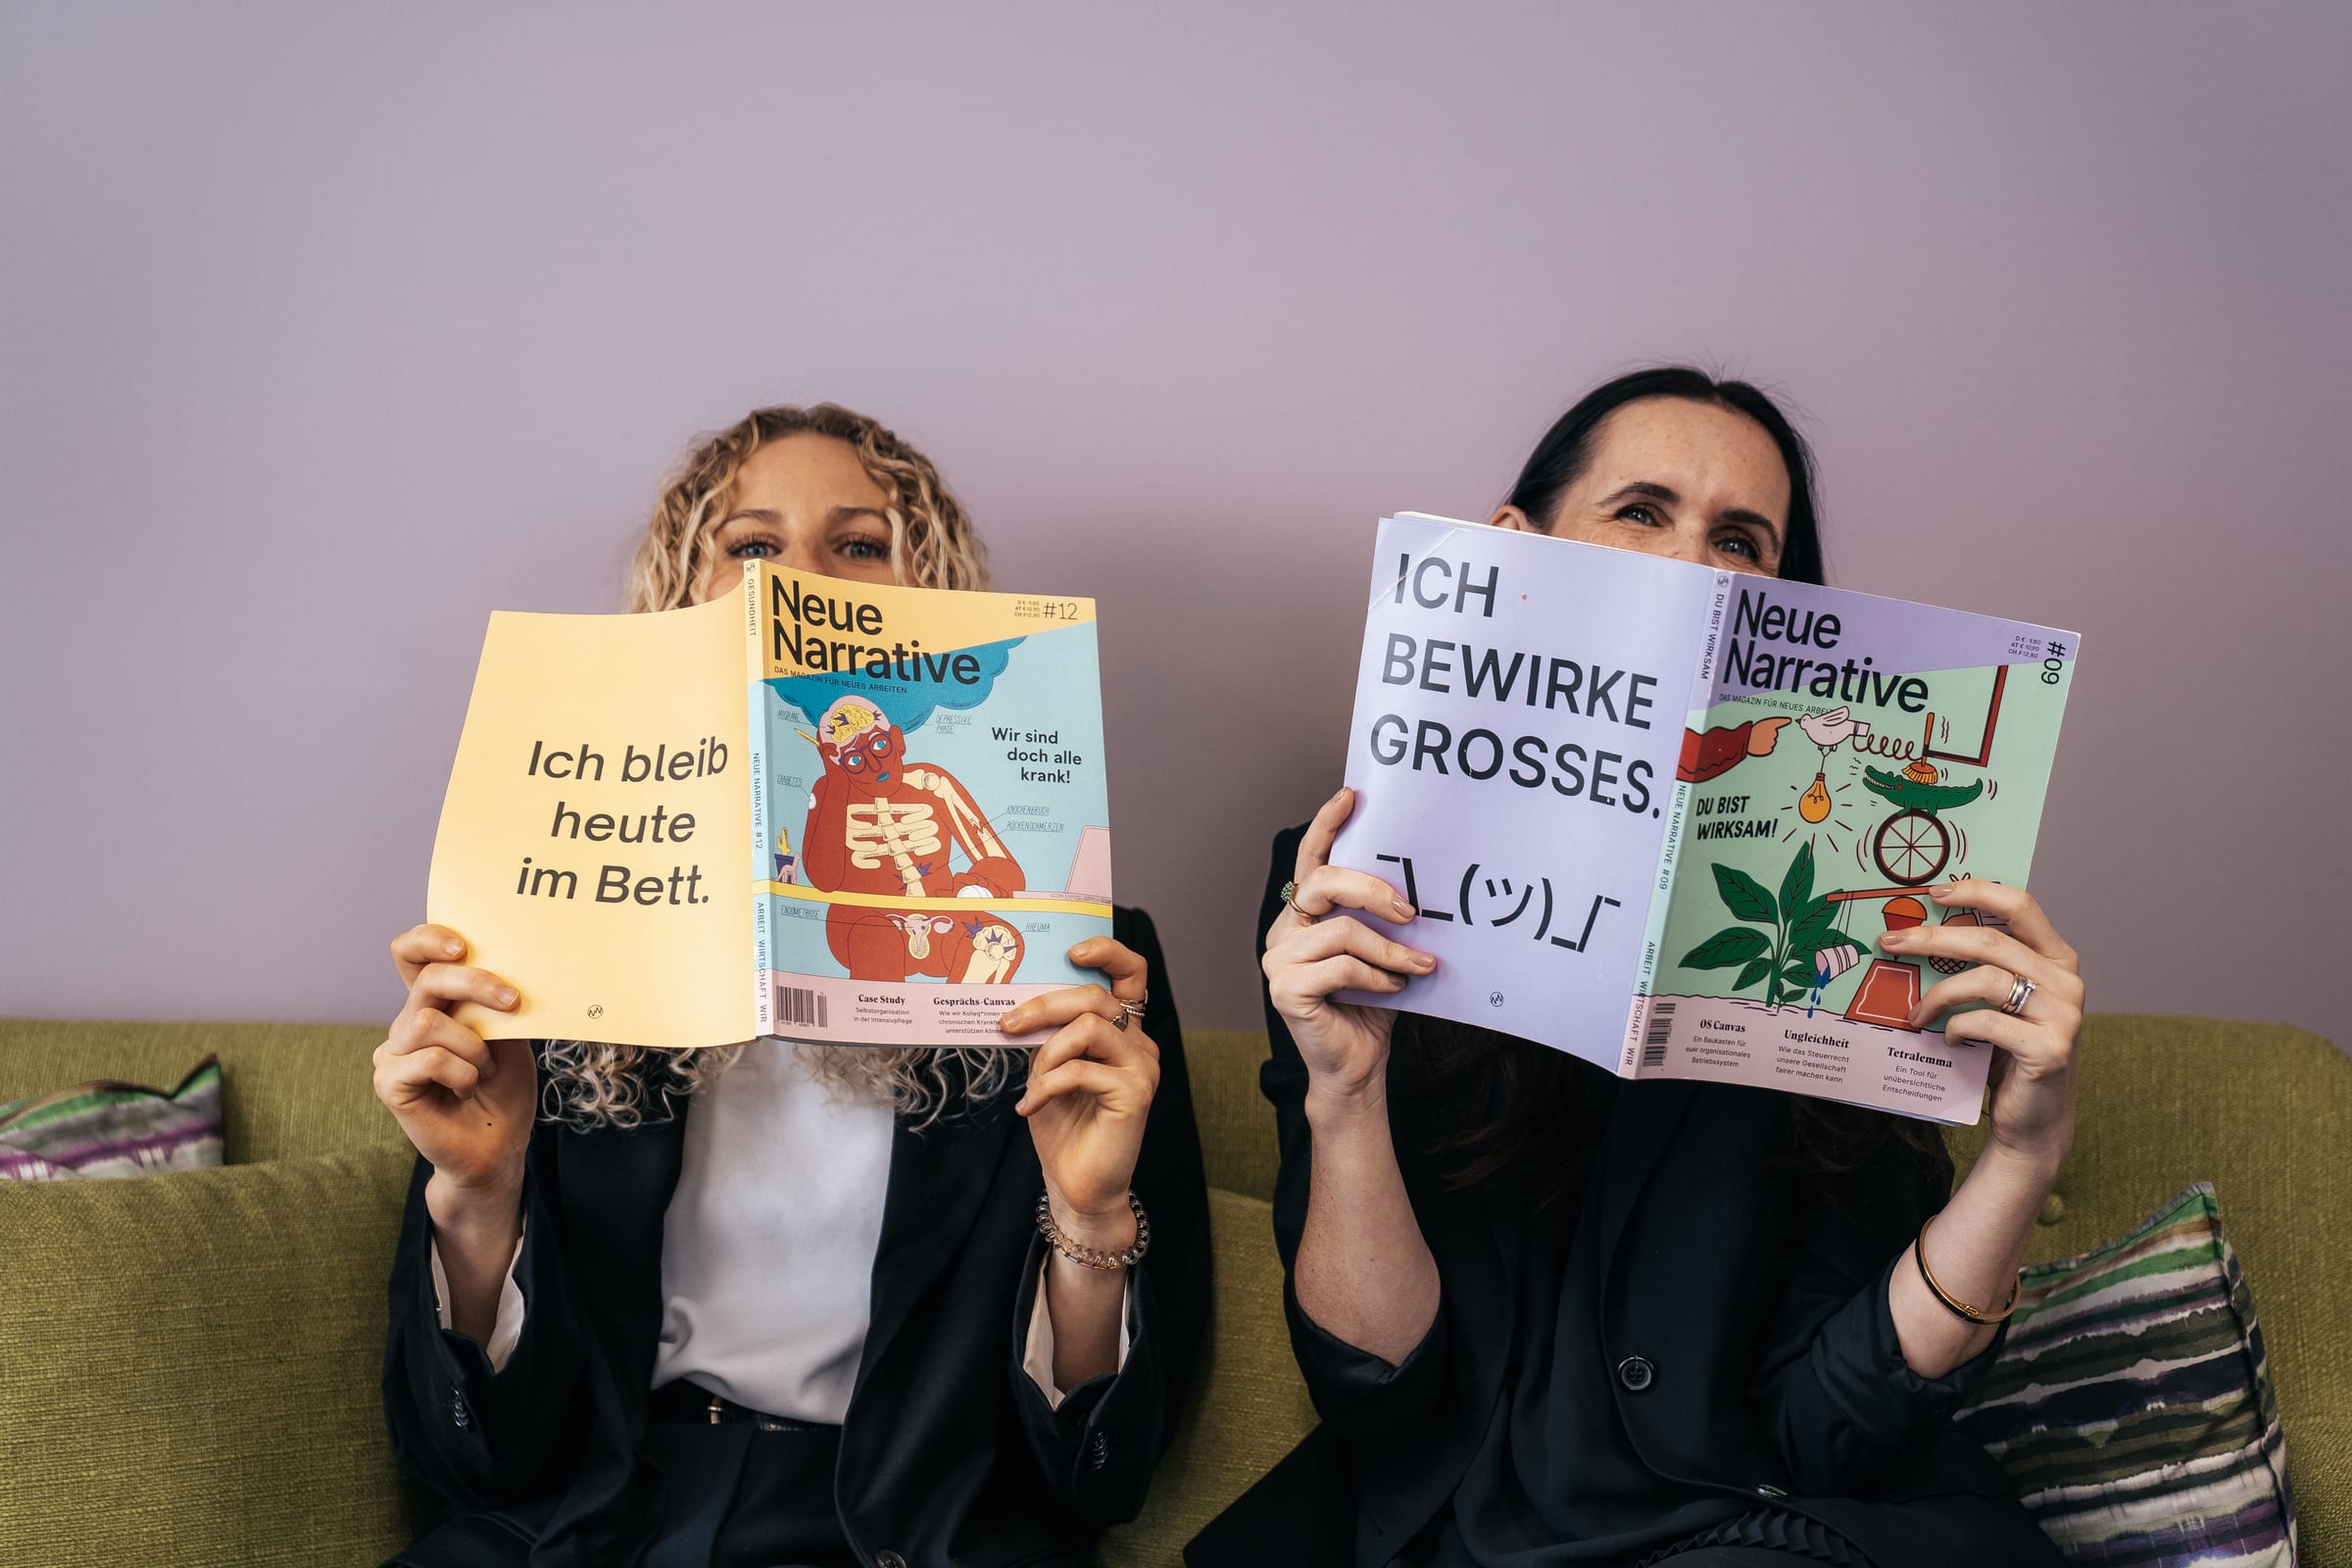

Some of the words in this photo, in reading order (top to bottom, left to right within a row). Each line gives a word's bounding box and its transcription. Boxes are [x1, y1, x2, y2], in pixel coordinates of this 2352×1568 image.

[1395, 553, 1499, 618] ICH
[748, 578, 757, 635] GESUNDHEIT
[771, 575, 883, 635] Neue
[1043, 602, 1078, 619] #12
[1715, 594, 1724, 608] DU
[1711, 610, 1721, 631] BIST
[1733, 589, 1840, 649] Neue
[773, 618, 981, 685] Narrative
[1701, 633, 1716, 680] WIRKSAM
[2041, 642, 2066, 684] #09
[790, 670, 822, 682] MAGAZIN
[825, 676, 839, 686] FÜR
[842, 680, 866, 690] NEUES
[868, 684, 907, 694] ARBEITEN
[1382, 632, 1658, 730] BEWIRKE
[1723, 638, 1929, 713] Narrative
[1732, 696, 1761, 706] MAGAZIN
[1764, 699, 1778, 708] FÜR
[1780, 702, 1803, 711] NEUES
[992, 727, 1020, 741] Wir
[1025, 729, 1058, 745] sind
[527, 740, 604, 781] Ich
[621, 736, 728, 783] bleib
[1007, 747, 1048, 762] doch
[1054, 751, 1082, 764] alle
[1370, 713, 1660, 819] GROSSES.
[1021, 766, 1070, 784] krank!
[754, 778, 762, 827] NARRATIVE
[1675, 784, 1686, 809] NEUE
[1695, 798, 1714, 816] DU
[1717, 796, 1750, 813] BIST
[551, 802, 695, 843] heute
[1697, 818, 1778, 841] WIRKSAM!
[1664, 811, 1681, 864] NARRATIVE
[516, 858, 576, 900] im
[595, 863, 710, 906] Bett.
[1659, 868, 1670, 890] #09
[1642, 941, 1654, 975] ARBEIT
[858, 994, 878, 1004] Case
[880, 996, 906, 1005] Study
[933, 997, 1015, 1007] Gesprächs-Canvas
[1630, 981, 1648, 1043] WIRTSCHAFT
[1700, 1019, 1711, 1029] OS
[1713, 1019, 1746, 1032] Canvas
[1703, 1037, 1735, 1046] Baukasten
[1785, 1029, 1849, 1049] Ungleichheit
[1625, 1048, 1635, 1066] WIR
[1691, 1056, 1739, 1067] Betriebssystem
[1699, 1047, 1750, 1058] organisationales
[1807, 1051, 1849, 1062] Steuerrecht
[1887, 1047, 1952, 1068] Tetralemma
[1776, 1066, 1794, 1075] fairer
[1795, 1070, 1823, 1080] machen
[1777, 1056, 1799, 1065] unsere
[1802, 1060, 1846, 1072] Gesellschaft
[1927, 1070, 1936, 1079] für
[1883, 1084, 1942, 1102] Entscheidungen
[1884, 1075, 1945, 1092] unübersichtliche
